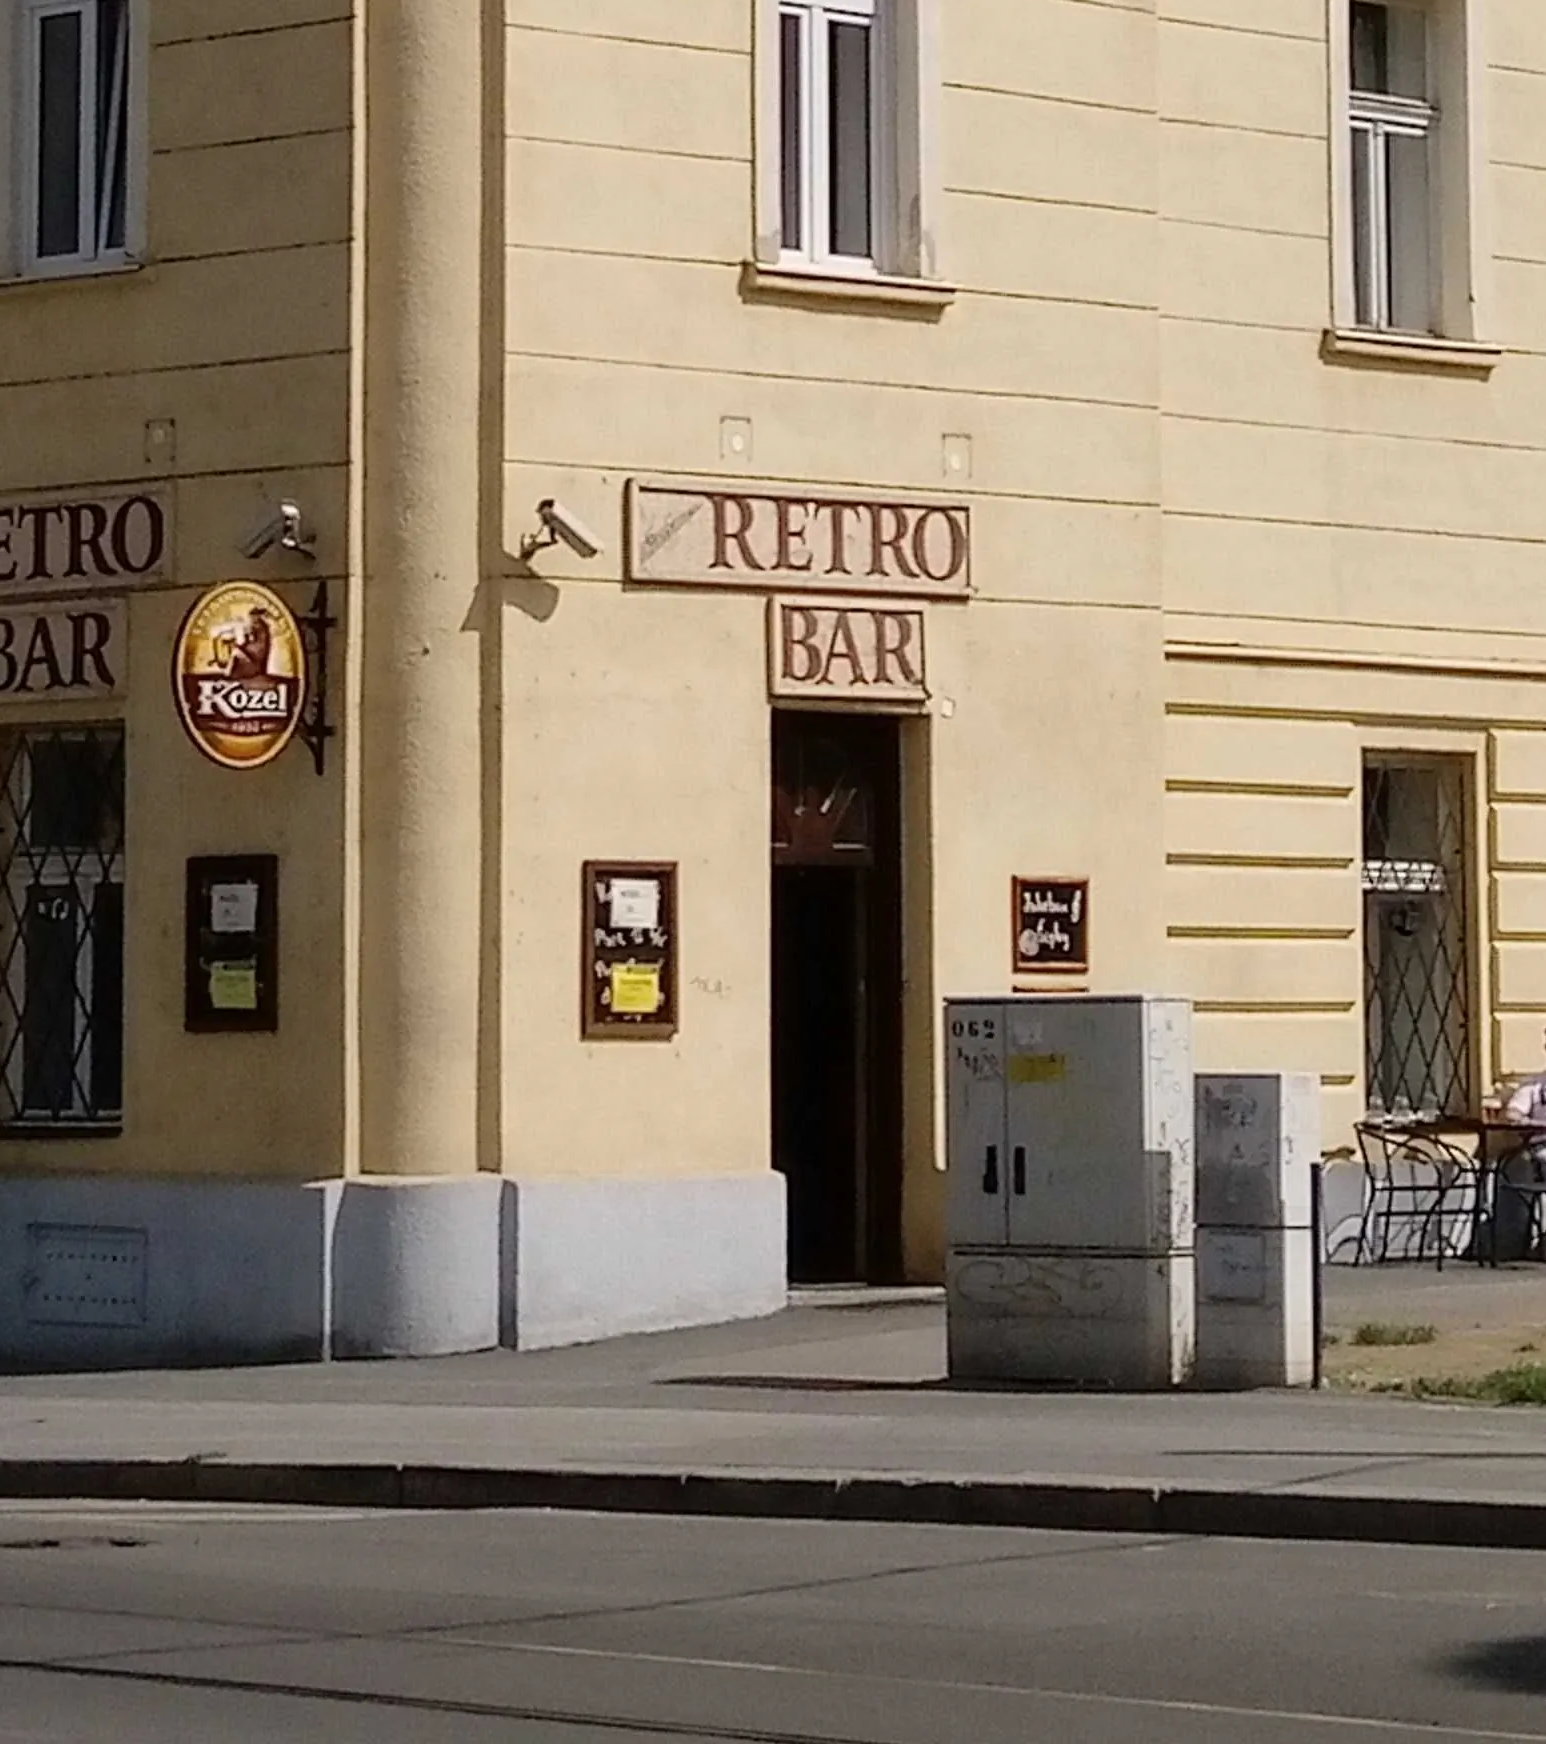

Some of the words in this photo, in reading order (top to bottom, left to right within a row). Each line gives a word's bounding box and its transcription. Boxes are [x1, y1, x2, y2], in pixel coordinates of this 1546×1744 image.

[707, 494, 966, 581] RETRO
[781, 609, 922, 685] BAR
[197, 680, 287, 718] Kozel
